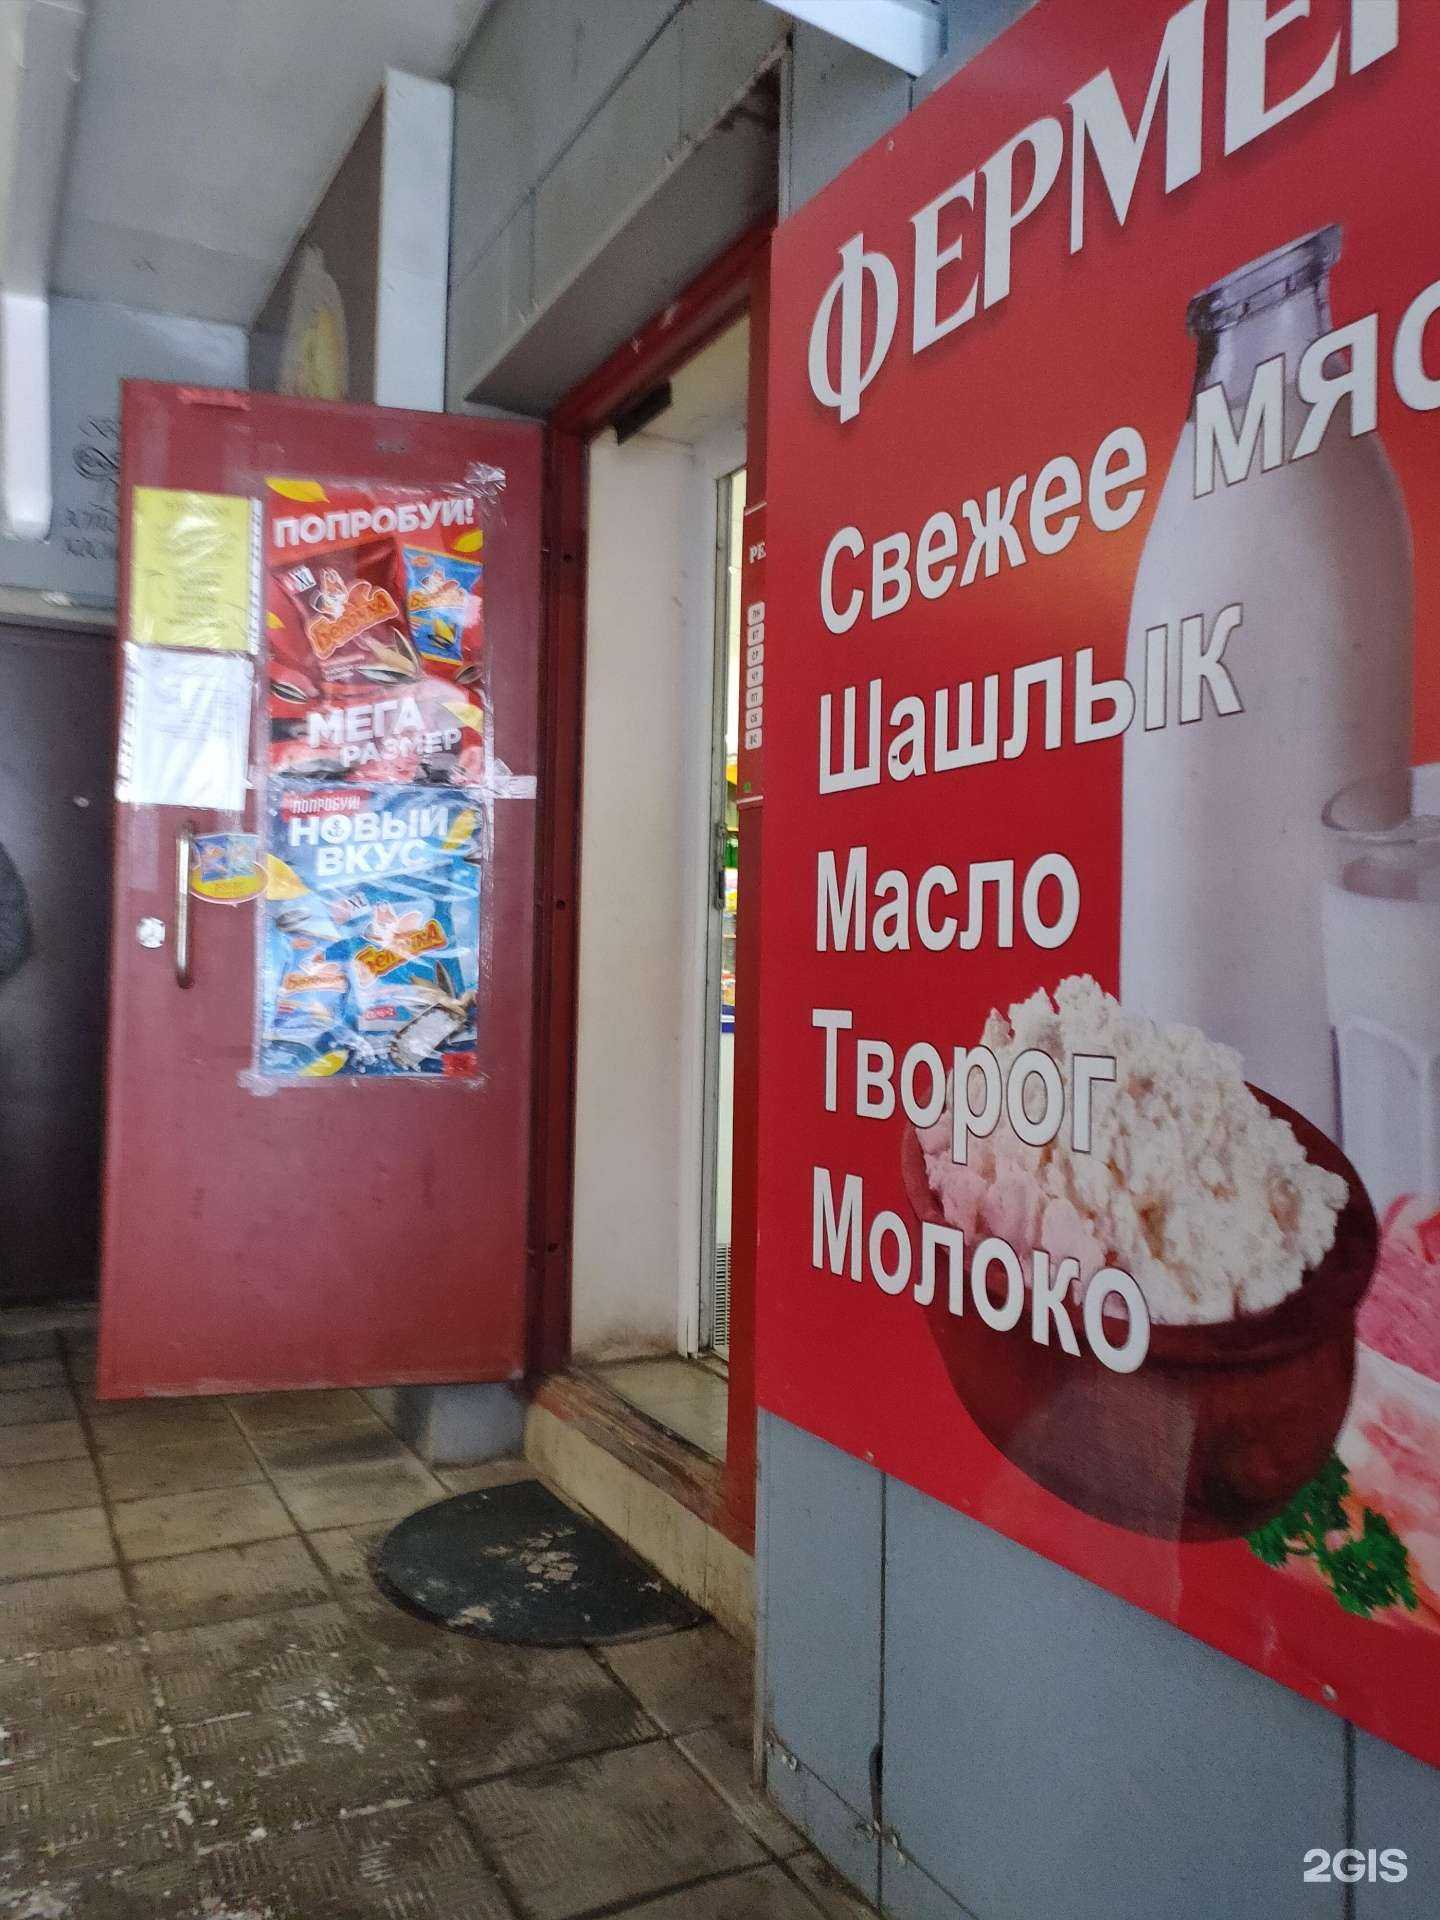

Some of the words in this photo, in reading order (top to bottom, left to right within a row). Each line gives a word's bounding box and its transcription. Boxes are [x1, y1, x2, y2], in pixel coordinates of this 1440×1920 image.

[820, 426, 1148, 635] Свежее
[306, 697, 425, 749] МЕГА
[818, 603, 1244, 796] Шашлык
[288, 804, 449, 847] НОВЫЙ
[317, 838, 428, 876] ВКУС
[815, 845, 1081, 954] Масло
[811, 1008, 1117, 1166] Творог
[811, 1166, 1152, 1374] Молоко
